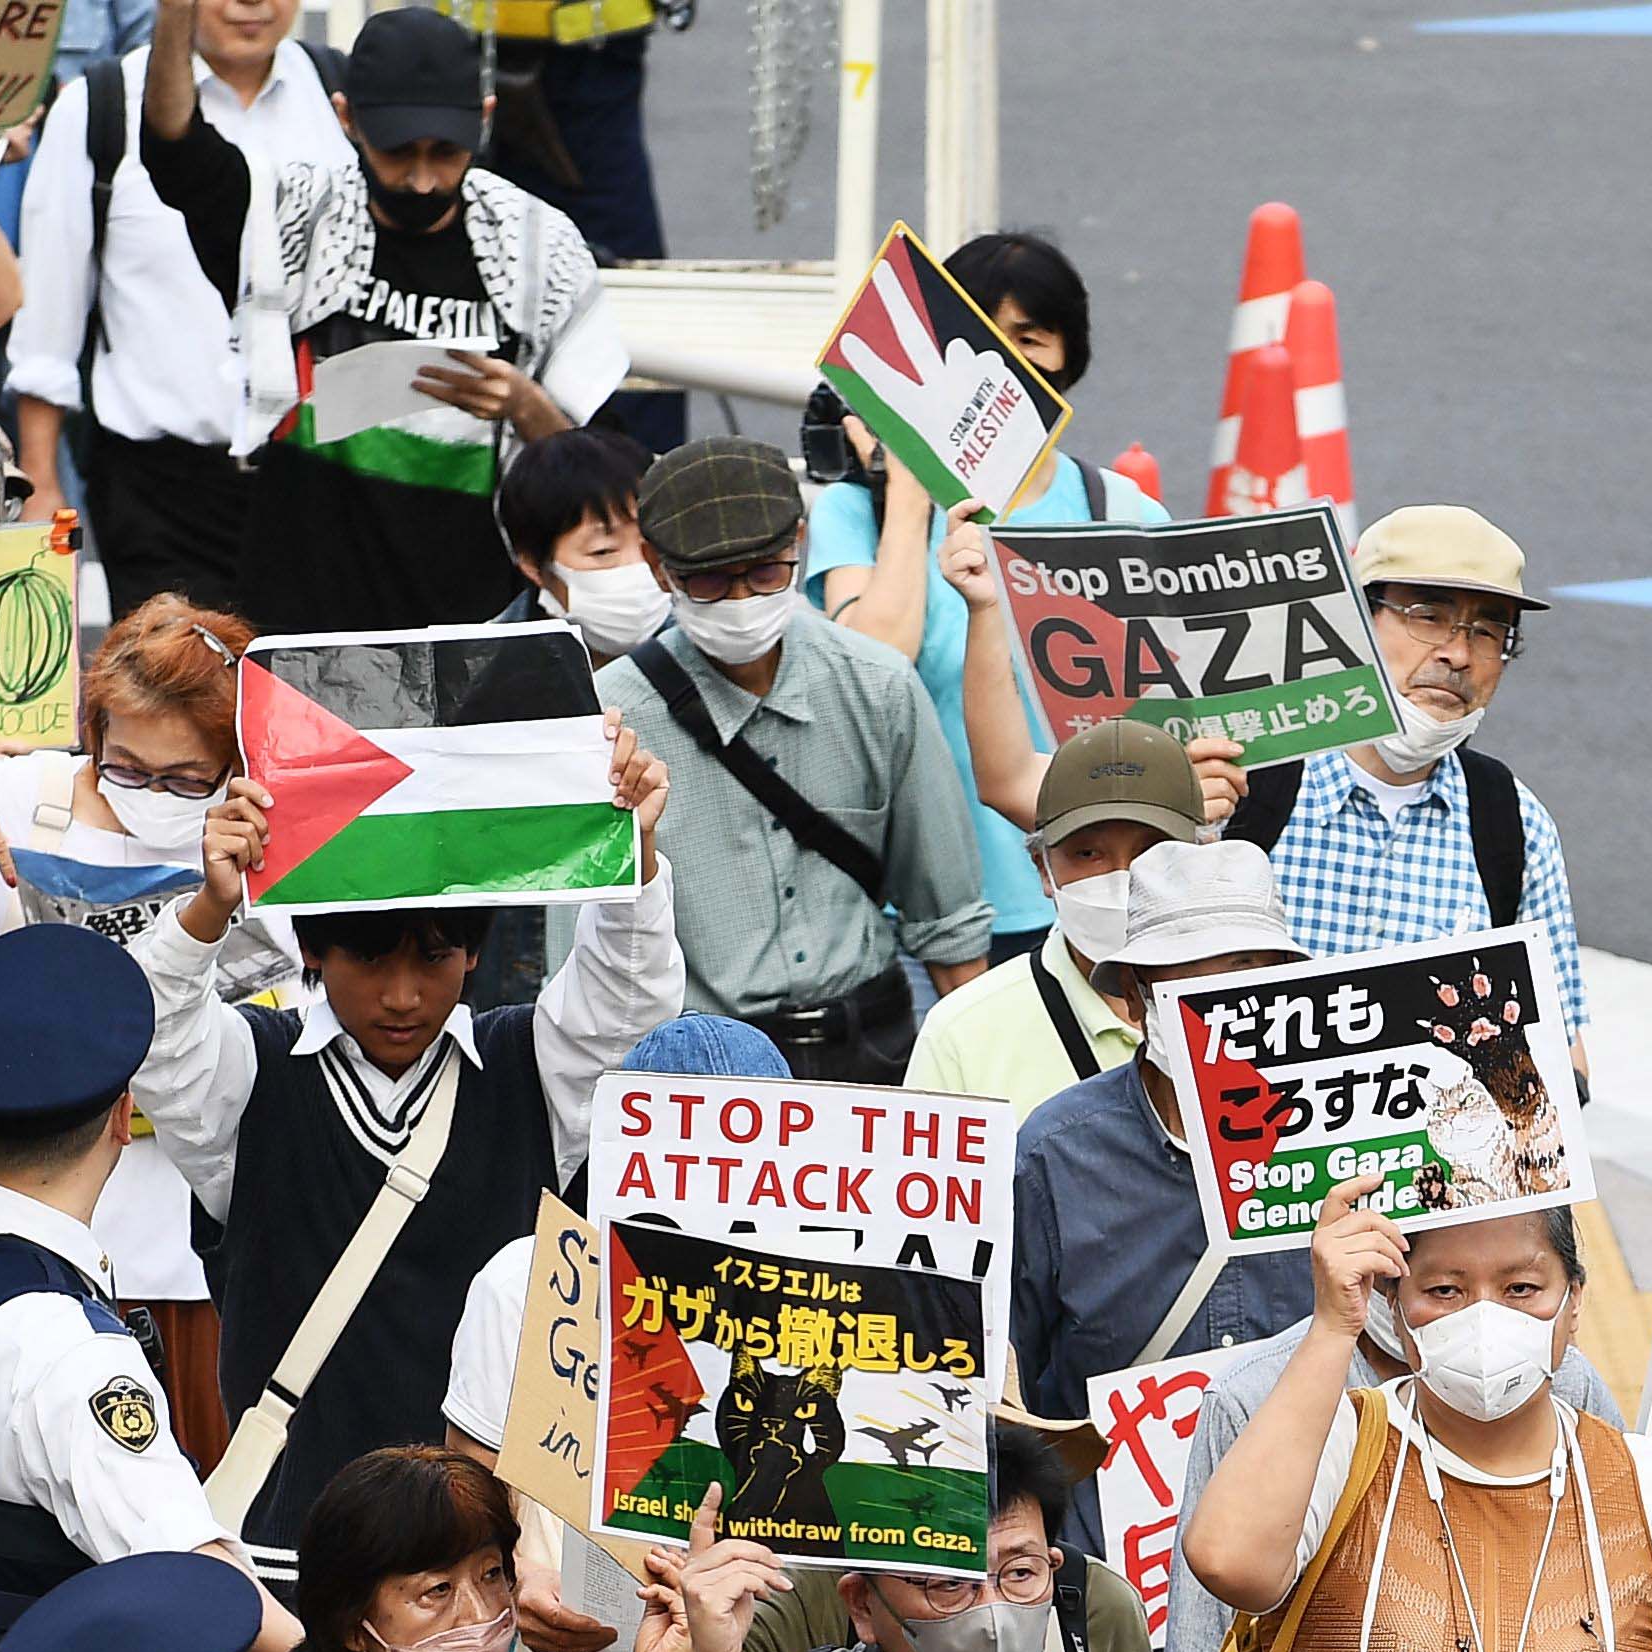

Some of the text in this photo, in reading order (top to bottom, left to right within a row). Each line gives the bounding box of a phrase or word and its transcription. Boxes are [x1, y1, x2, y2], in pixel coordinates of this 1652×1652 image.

[843, 62, 874, 98] 7
[949, 376, 997, 447] STAND WITH
[954, 380, 1023, 480] PALESTINE
[1005, 546, 1330, 601] Stop Bombing
[1030, 599, 1365, 699] GAZA
[1203, 984, 1385, 1065] だれも
[620, 1090, 987, 1165] STOP THE
[1217, 1062, 1431, 1142] ころすな
[616, 1151, 983, 1225] ATTACK ON
[1229, 1142, 1425, 1193] Stop Gaza
[712, 1254, 863, 1304] イスラエルは
[620, 1274, 978, 1378] ガザから撤退しろ
[538, 1407, 591, 1480] in
[612, 1486, 669, 1520] Israel
[728, 1517, 842, 1544] withdraw
[849, 1520, 908, 1547] from
[911, 1526, 979, 1555] Gaza.
